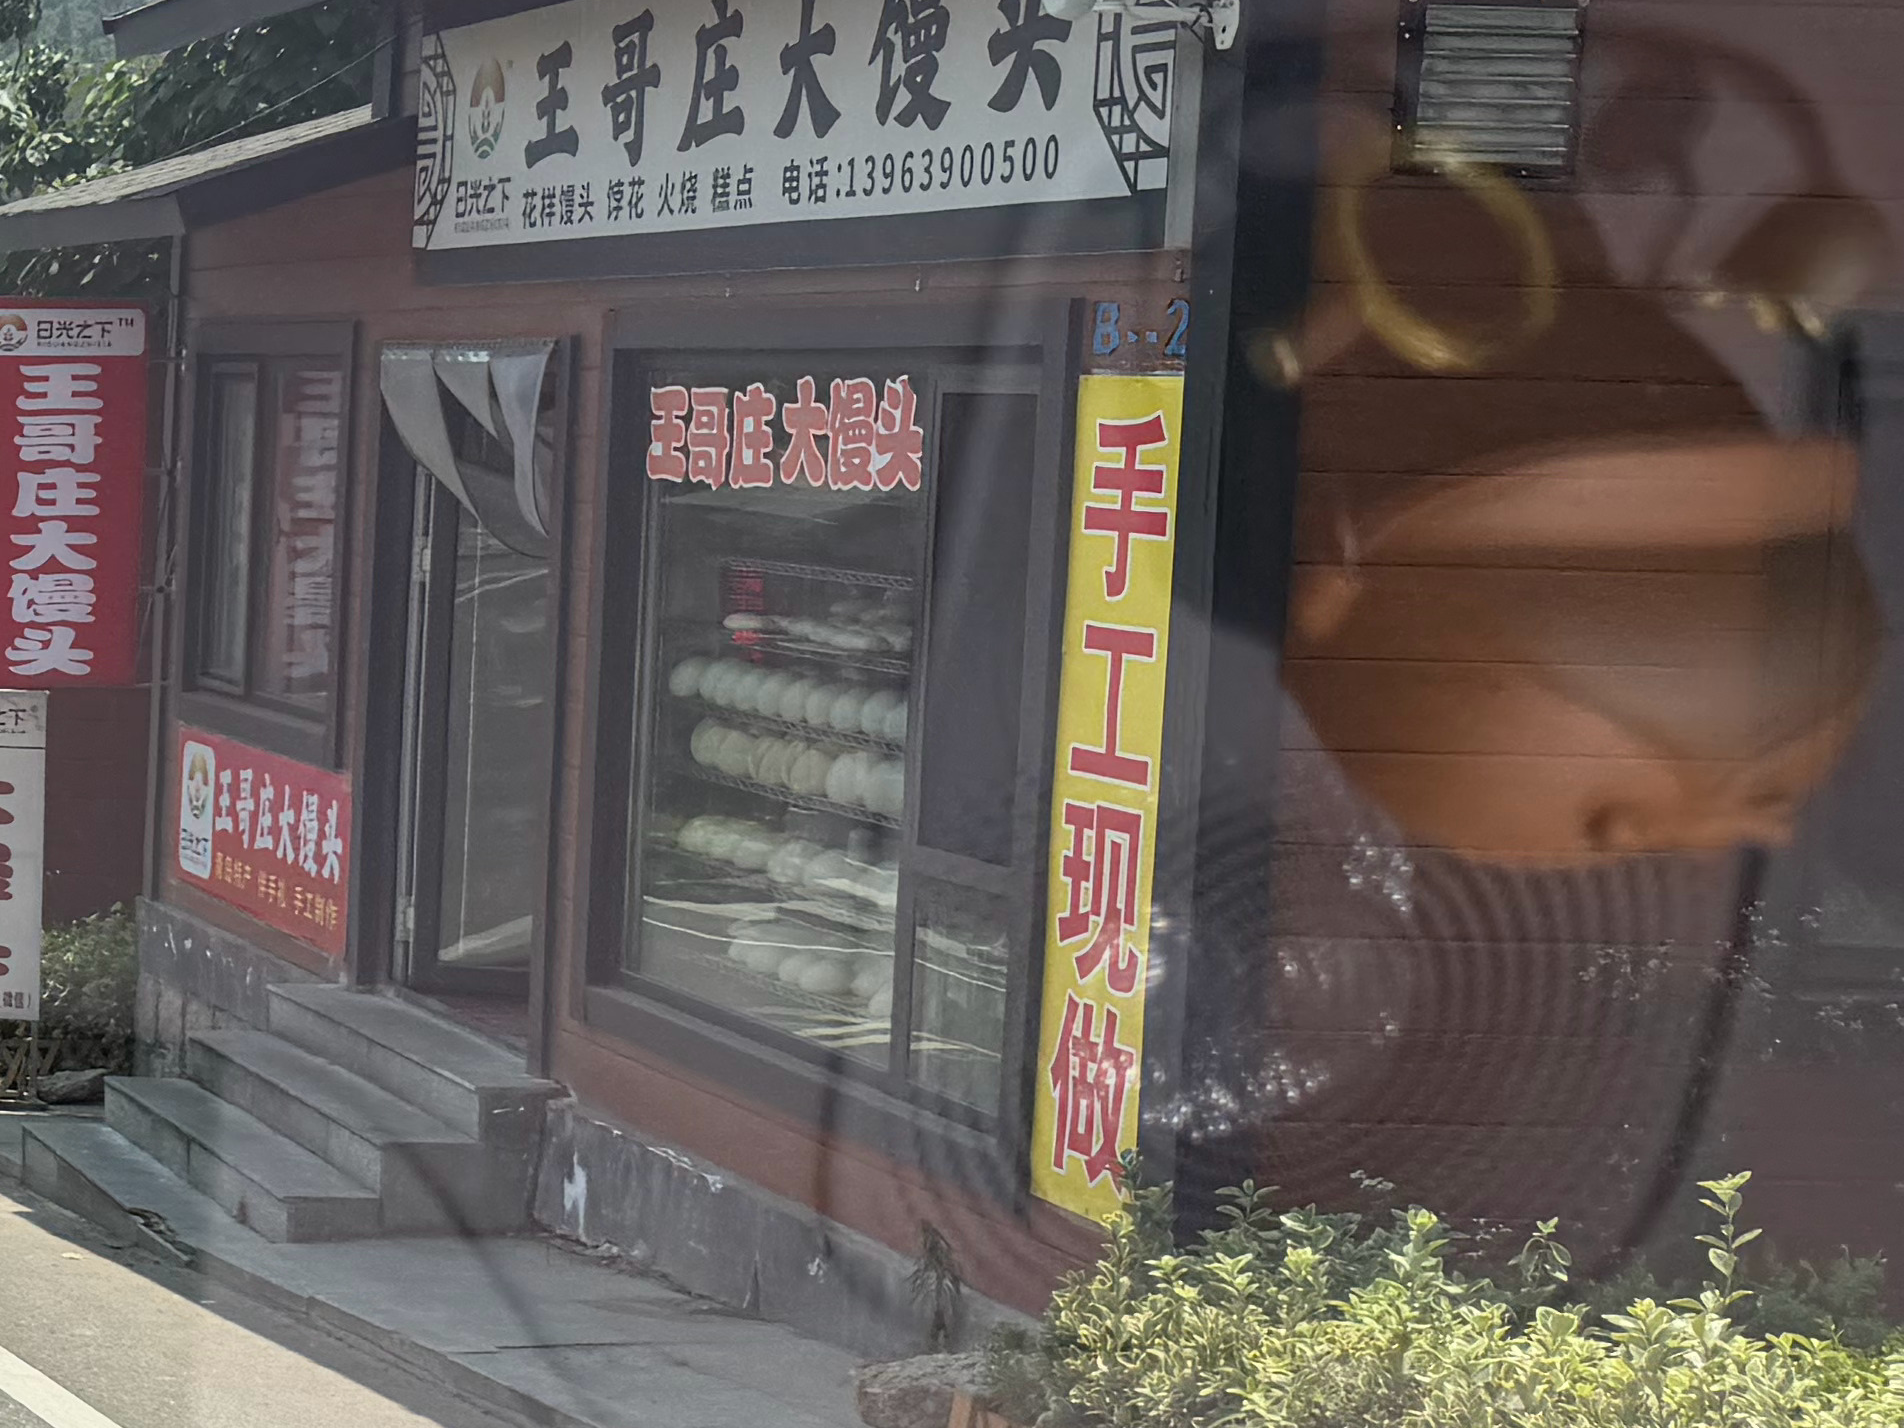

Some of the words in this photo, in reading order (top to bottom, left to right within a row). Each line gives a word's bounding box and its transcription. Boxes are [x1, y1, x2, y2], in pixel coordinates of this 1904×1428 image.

[522, 182, 594, 229] 花样馒头
[658, 171, 698, 217] 火烧
[712, 163, 755, 213] 糕点
[36, 319, 113, 339] 日光之下
[648, 374, 924, 491] 王哥庄大馒头
[4, 363, 103, 677] 王哥庄大馒头
[215, 768, 343, 884] 王哥庄大馒头
[1050, 410, 1169, 1202] 手工现做
